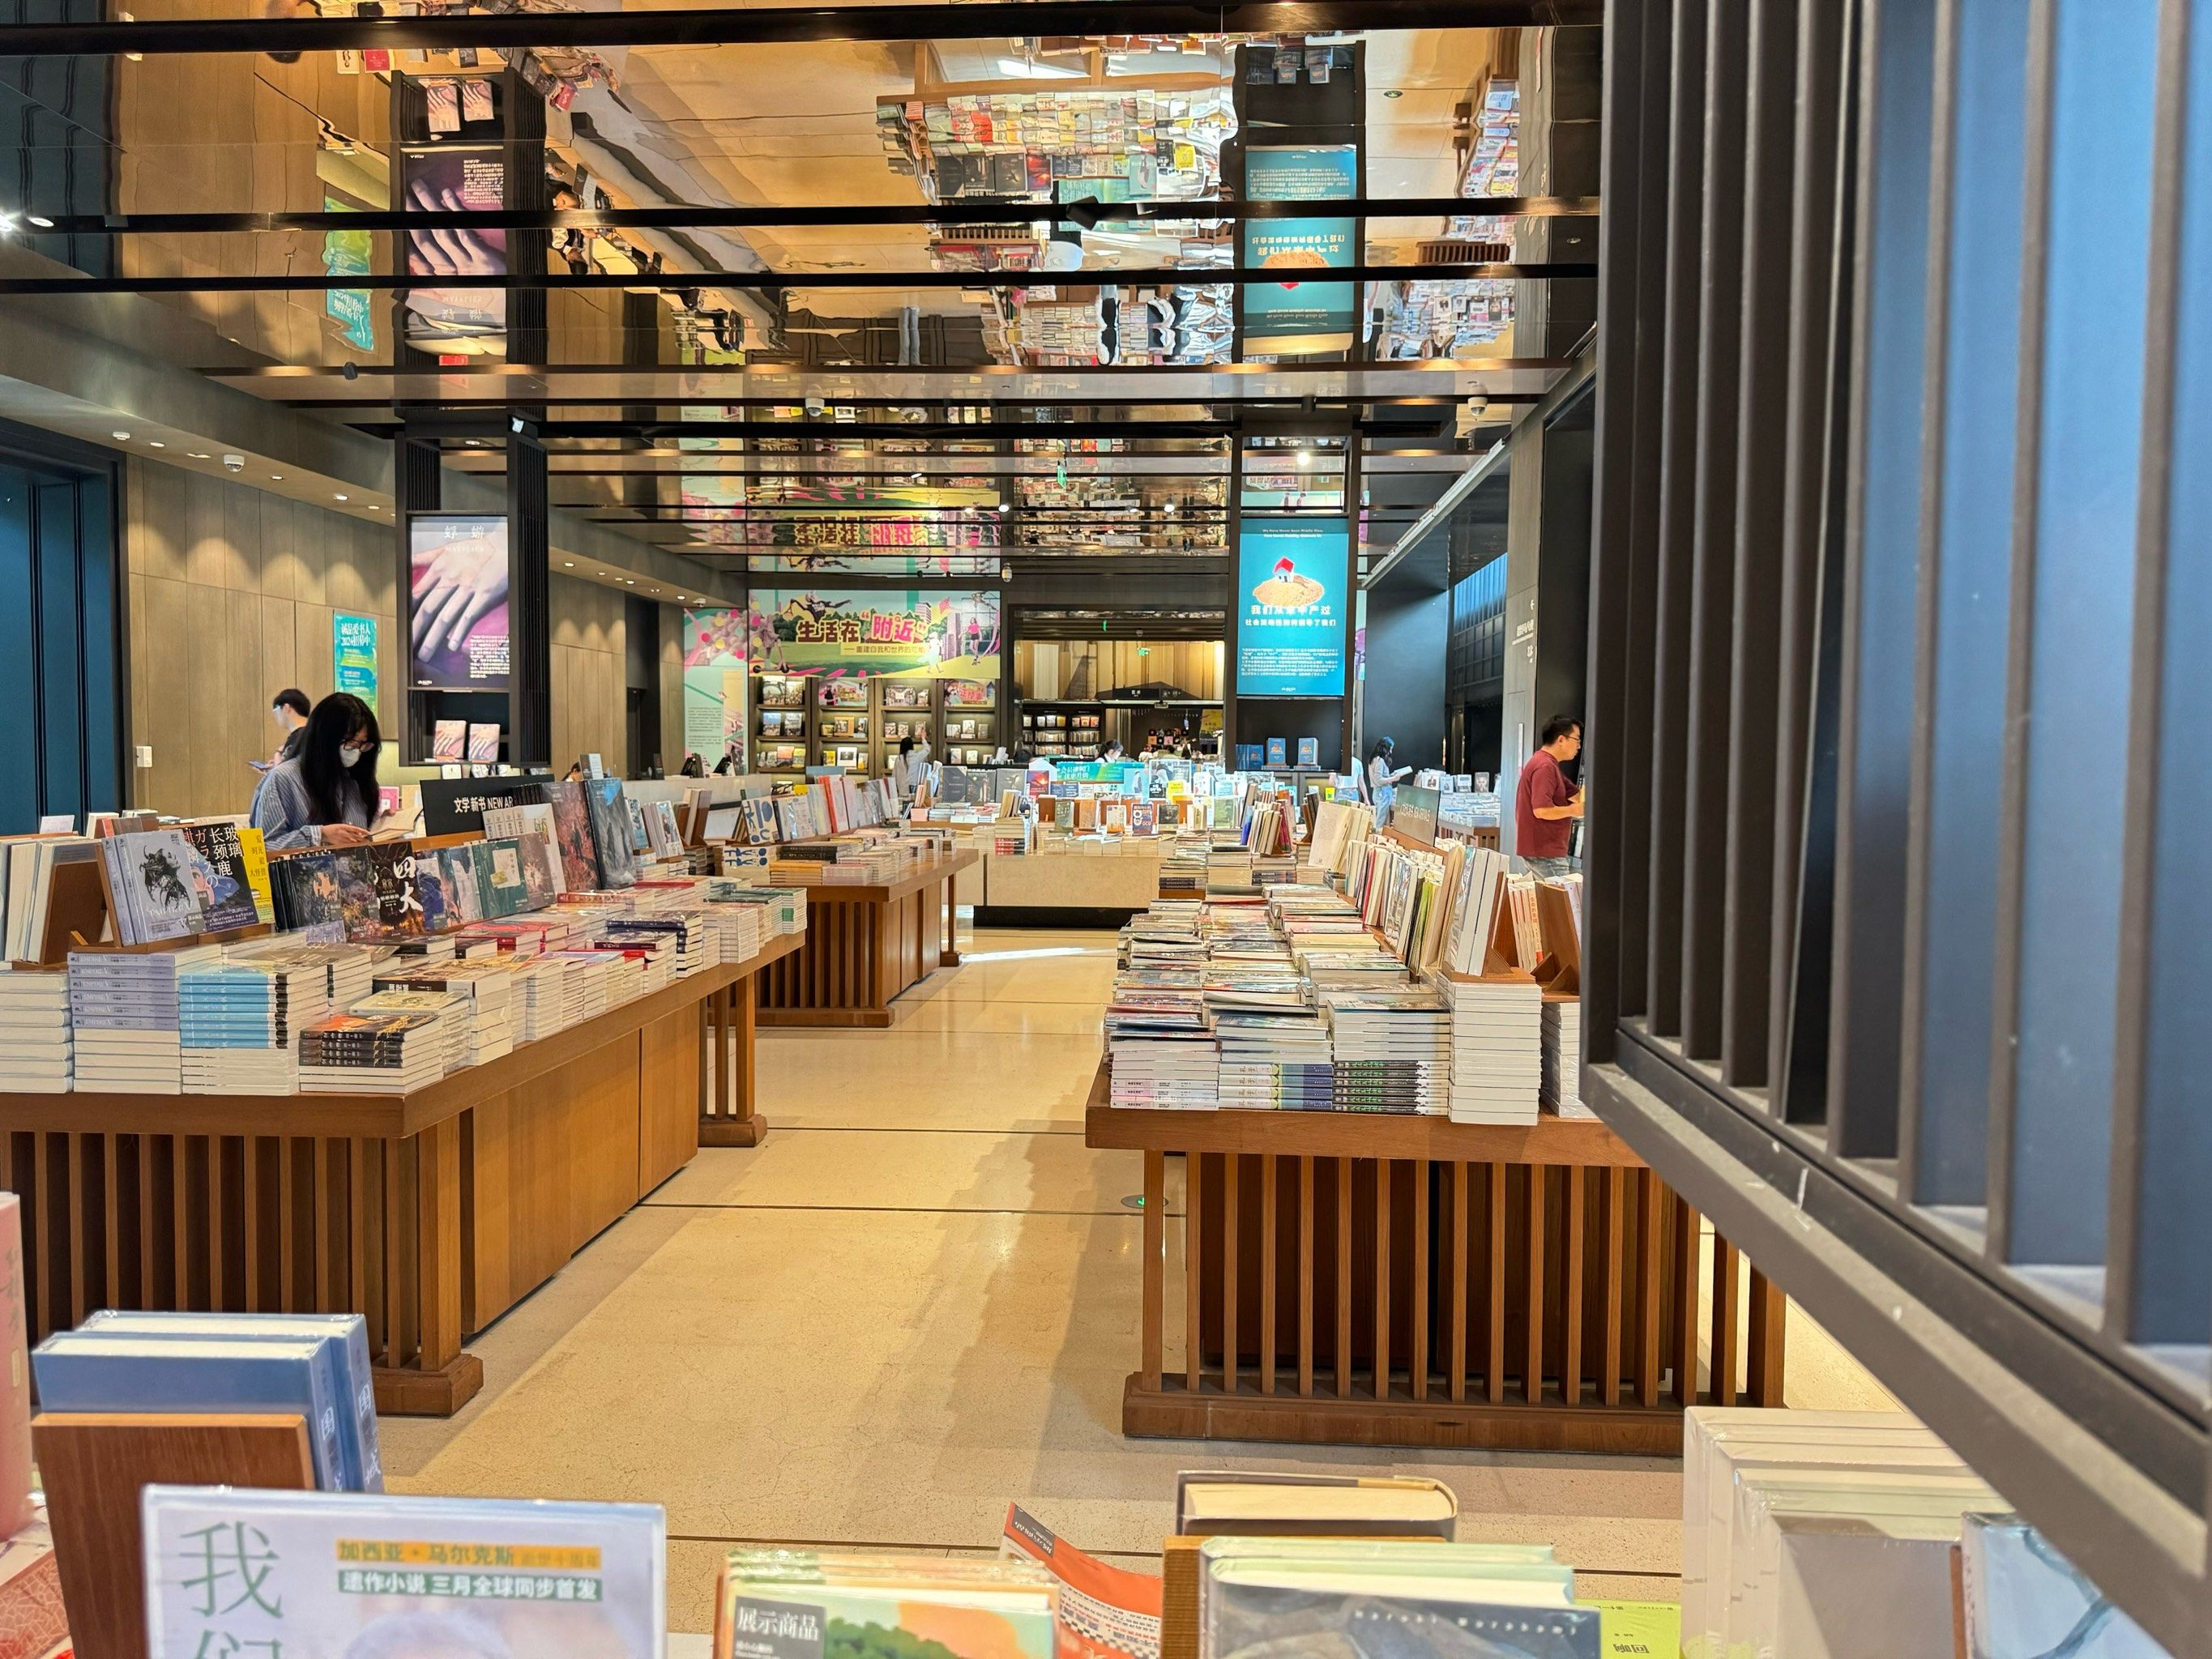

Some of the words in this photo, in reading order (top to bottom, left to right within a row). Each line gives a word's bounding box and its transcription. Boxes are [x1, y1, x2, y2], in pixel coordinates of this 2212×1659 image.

[487, 796, 503, 809] NEW
[209, 827, 233, 876] 长颈鹿
[224, 825, 243, 858] 玻璃
[737, 1606, 819, 1641] 展示商品
